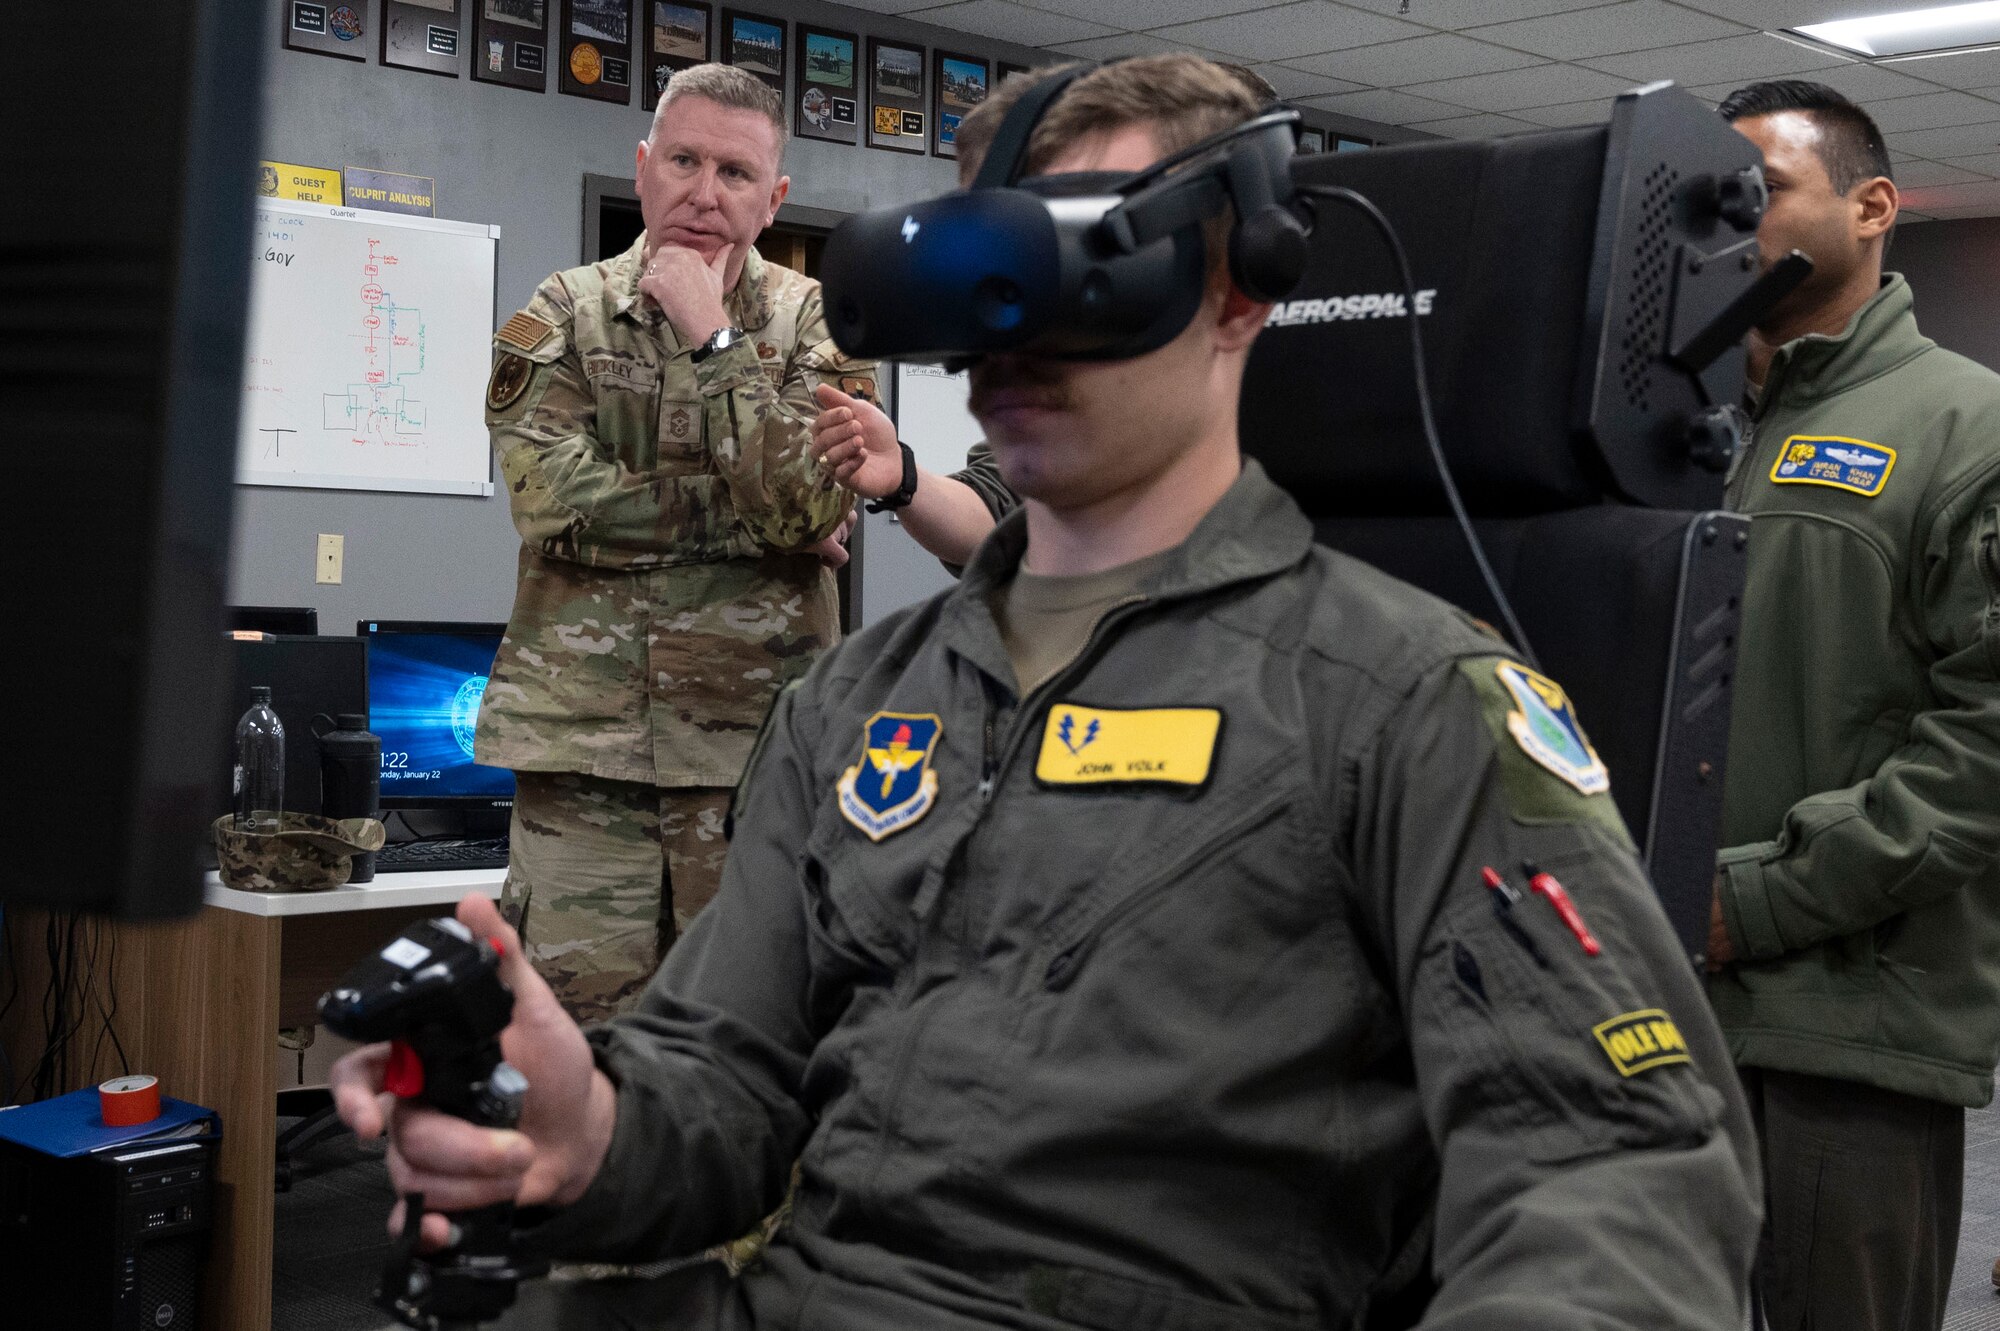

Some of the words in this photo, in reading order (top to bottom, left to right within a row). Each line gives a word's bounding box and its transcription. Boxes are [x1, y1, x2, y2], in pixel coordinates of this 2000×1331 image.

[292, 176, 326, 189] GUEST
[297, 190, 323, 203] HELP
[350, 186, 387, 202] CULPRIT
[388, 194, 431, 208] ANALYSIS
[330, 208, 356, 219] Quartet
[380, 770, 402, 780] onday,
[403, 770, 431, 780] January
[431, 770, 441, 779] 22
[1076, 763, 1113, 776] JOHN
